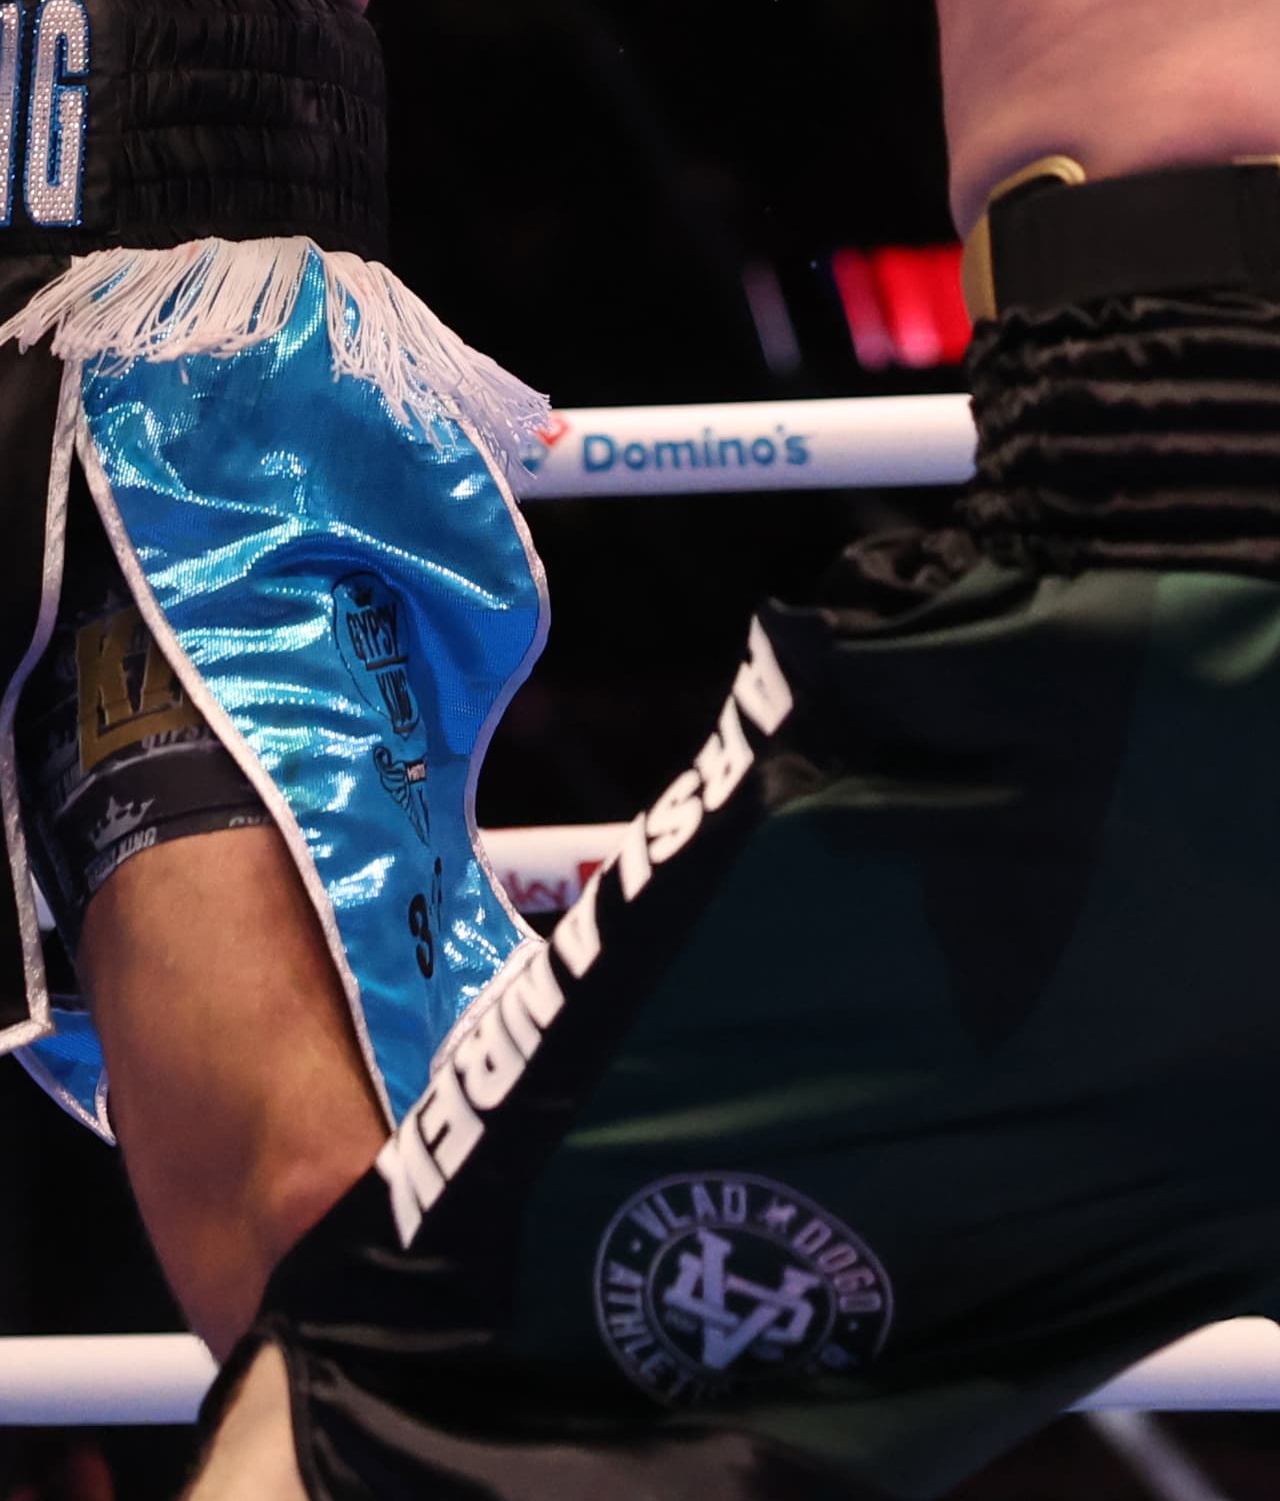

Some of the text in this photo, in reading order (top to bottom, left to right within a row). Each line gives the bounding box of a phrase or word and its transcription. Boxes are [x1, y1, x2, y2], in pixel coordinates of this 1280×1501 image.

[582, 424, 811, 473] Domino's
[375, 614, 795, 1250] ARSLANBEK
[628, 1182, 747, 1241] VLAD
